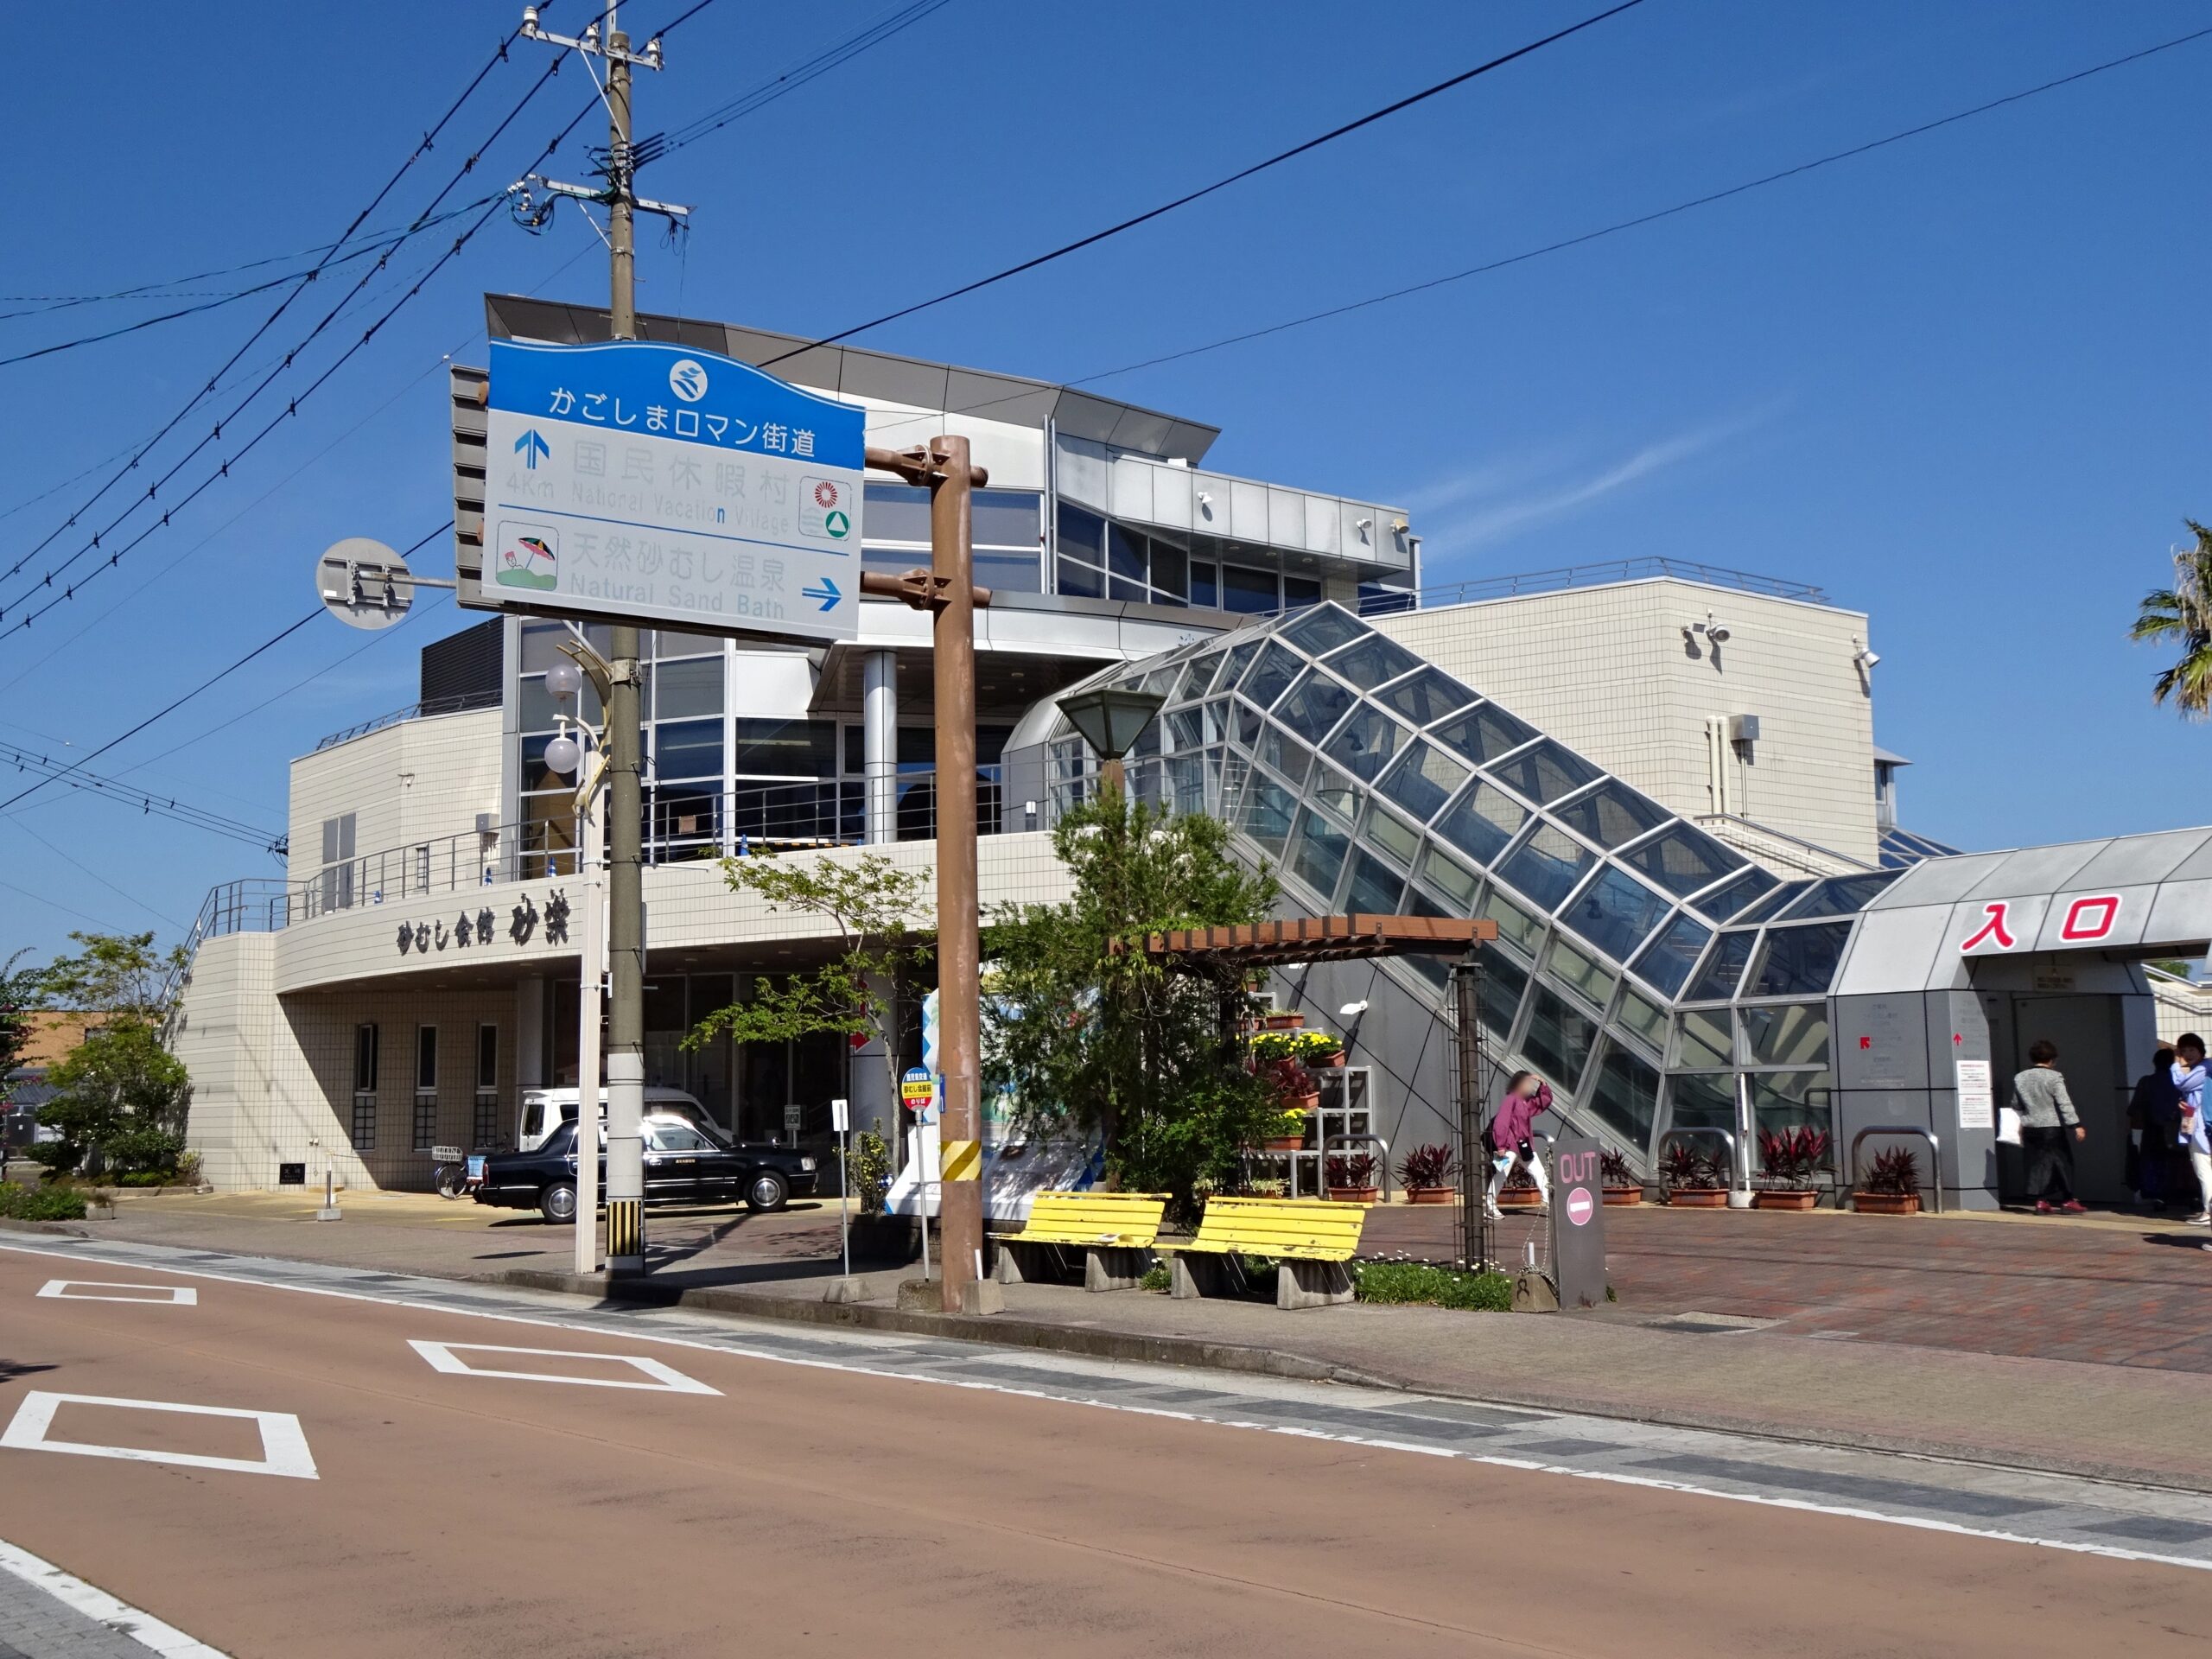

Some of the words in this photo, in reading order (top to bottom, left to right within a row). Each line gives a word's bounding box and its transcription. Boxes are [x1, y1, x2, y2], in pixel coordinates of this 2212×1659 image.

[550, 387, 816, 457] かごしまロマン街道
[505, 472, 554, 499] 4Km
[574, 440, 790, 505] 国民休暇村
[571, 480, 643, 512] National
[654, 493, 725, 524] Vacation
[735, 505, 789, 536] Village
[570, 532, 785, 592] 天然砂むし温泉
[570, 572, 653, 604] Natural
[669, 585, 722, 612] Sand
[737, 594, 784, 620] Bath
[1961, 896, 2120, 950] 入口
[1560, 1151, 1596, 1184] OUT
